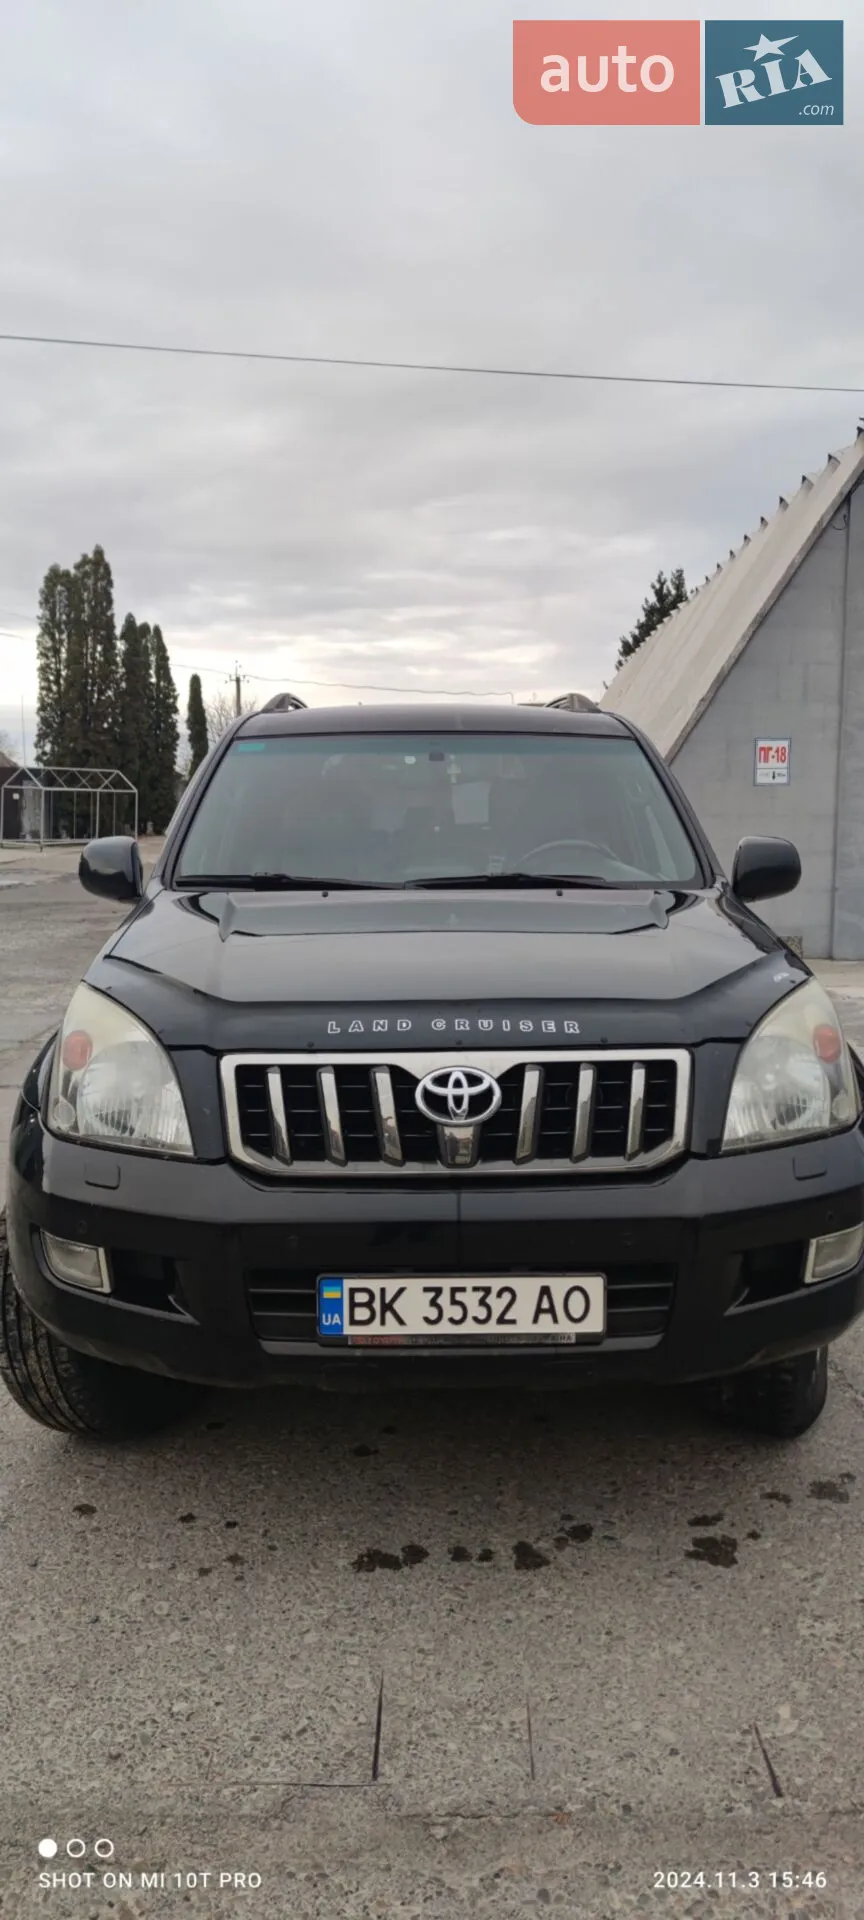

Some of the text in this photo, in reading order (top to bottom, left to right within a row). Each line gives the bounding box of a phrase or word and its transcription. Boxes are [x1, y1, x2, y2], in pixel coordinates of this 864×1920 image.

[328, 1019, 580, 1034] LAND CRUISER
[348, 1285, 591, 1327] BK 3532 AO
[322, 1314, 341, 1325] UA
